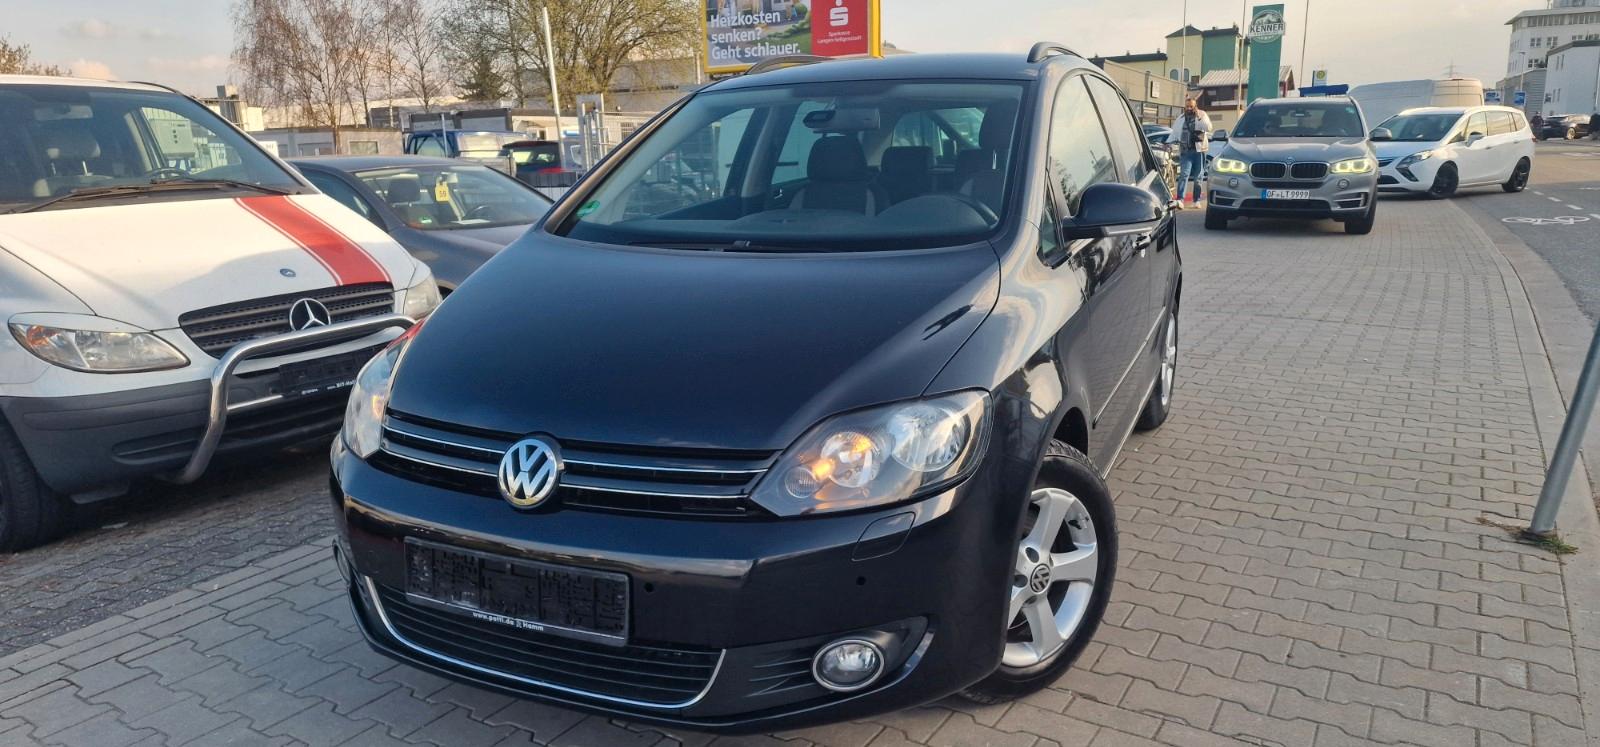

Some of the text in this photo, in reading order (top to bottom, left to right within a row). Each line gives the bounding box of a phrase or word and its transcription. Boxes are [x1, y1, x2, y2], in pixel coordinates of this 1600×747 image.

[711, 11, 780, 28] Heizkosten
[1250, 23, 1284, 33] KENNER
[711, 27, 762, 44] senken?
[712, 42, 801, 59] Geht schlauer.
